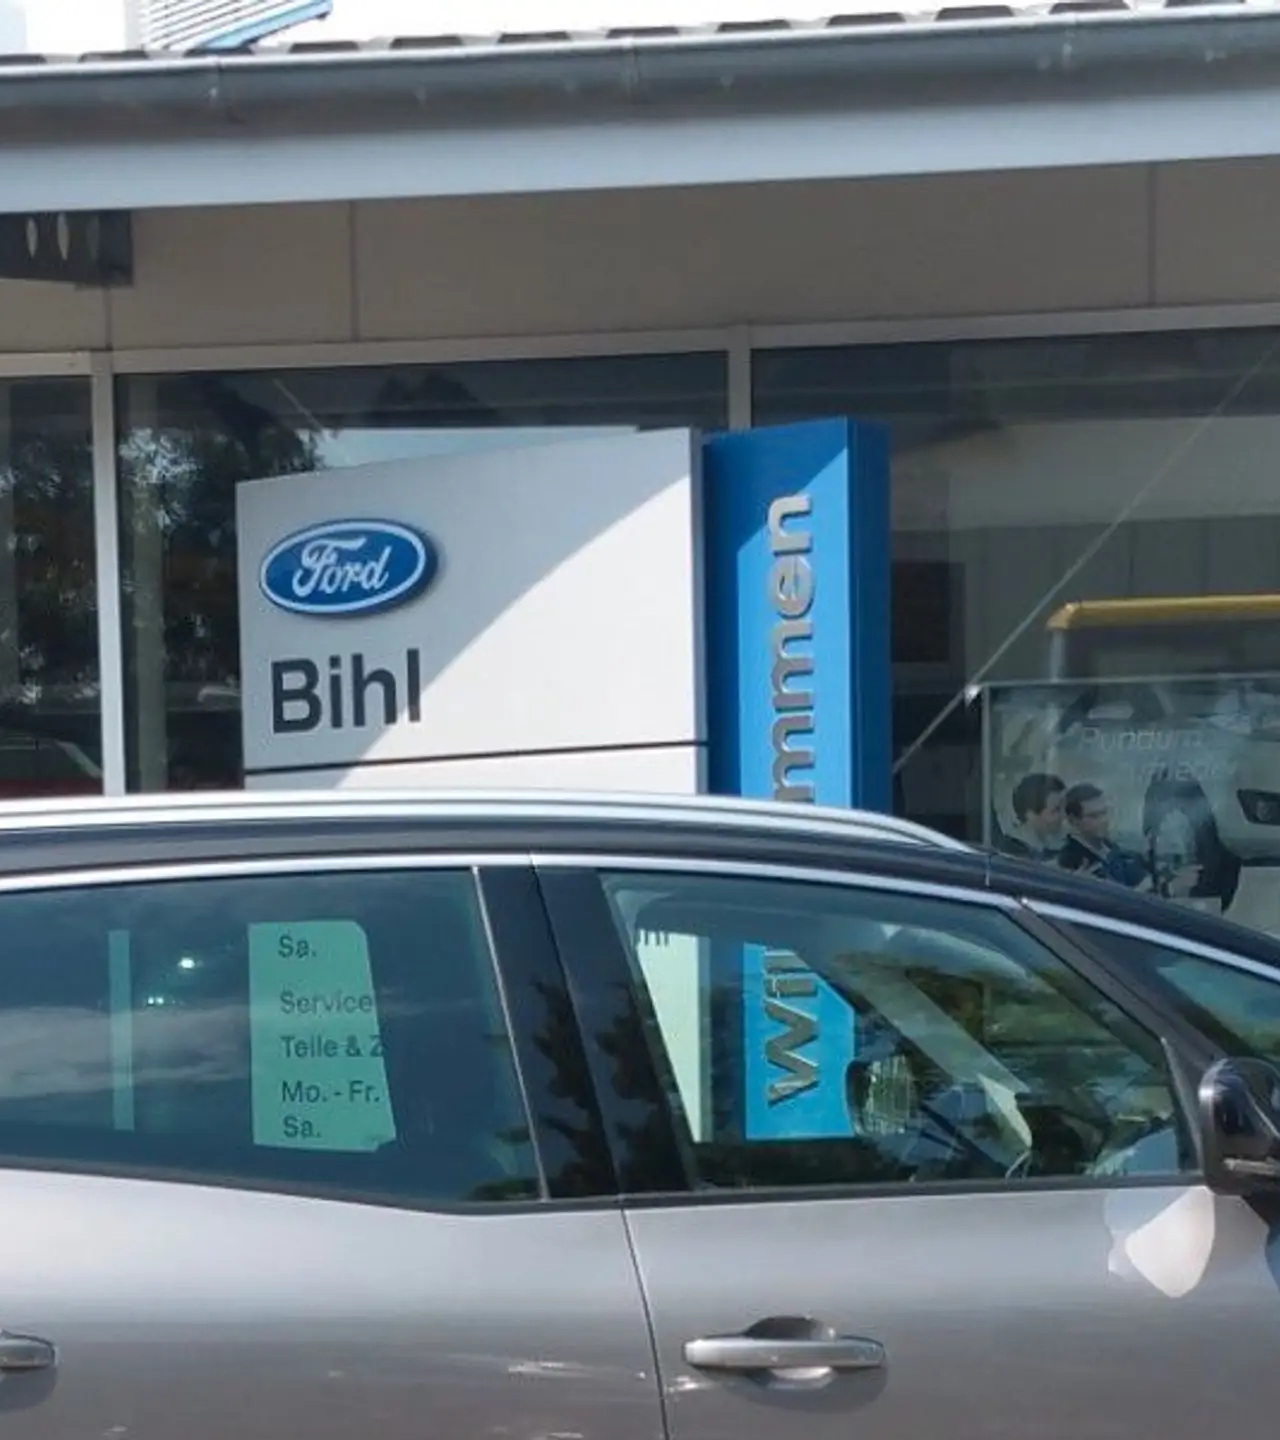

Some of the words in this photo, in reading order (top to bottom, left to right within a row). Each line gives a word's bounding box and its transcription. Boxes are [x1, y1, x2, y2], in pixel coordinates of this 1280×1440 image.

[292, 536, 391, 597] Ford
[271, 648, 421, 733] Bihl
[278, 935, 317, 958] Sa.
[279, 989, 373, 1014] Service
[281, 1036, 337, 1058] Teile
[345, 1036, 363, 1057] &
[281, 1080, 328, 1103] Mo.
[349, 1080, 380, 1103] Fr.
[282, 1116, 322, 1139] Sa.
